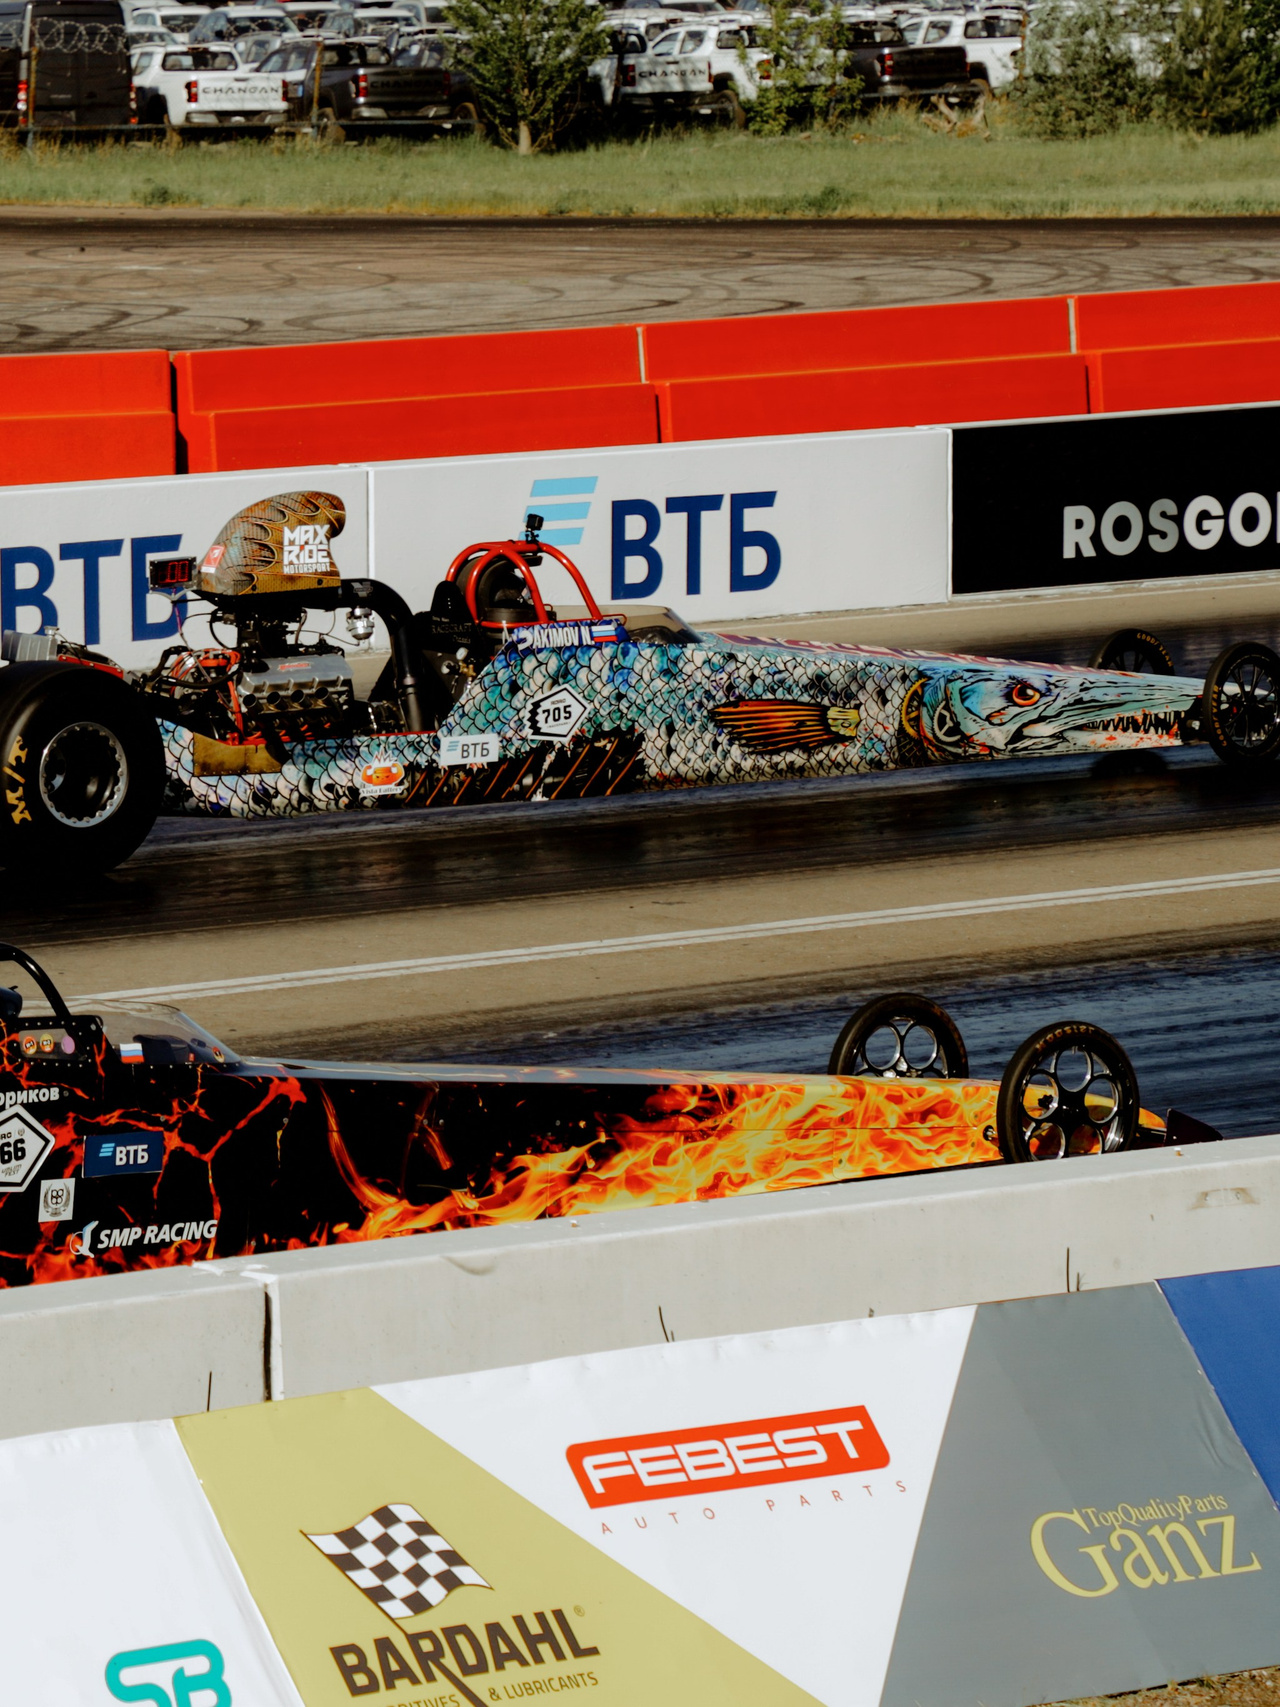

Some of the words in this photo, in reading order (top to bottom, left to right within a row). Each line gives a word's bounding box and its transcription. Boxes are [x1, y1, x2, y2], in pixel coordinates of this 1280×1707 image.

[638, 68, 706, 79] CHANGAN
[201, 85, 280, 95] CHANGAN
[283, 524, 330, 546] MAX
[1063, 491, 1280, 559] ROSGO
[611, 490, 781, 600] ВТБ
[283, 562, 330, 574] MOTORSPORT
[0, 534, 188, 646] ВТБ
[532, 626, 579, 649] AKIMOV
[542, 704, 572, 724] 705
[461, 742, 490, 759] ВТБ
[115, 1144, 149, 1166] ВТБ
[97, 1226, 143, 1249] SMP
[143, 1219, 218, 1245] RACING
[582, 1419, 864, 1494] FEBEST
[600, 1507, 716, 1535] AUTO
[765, 1480, 907, 1512] PARTS
[1030, 1508, 1262, 1598] Ganz
[329, 1608, 600, 1698] BARDAHL
[488, 1686, 501, 1702] &
[503, 1671, 599, 1700] LUBRICANTS
